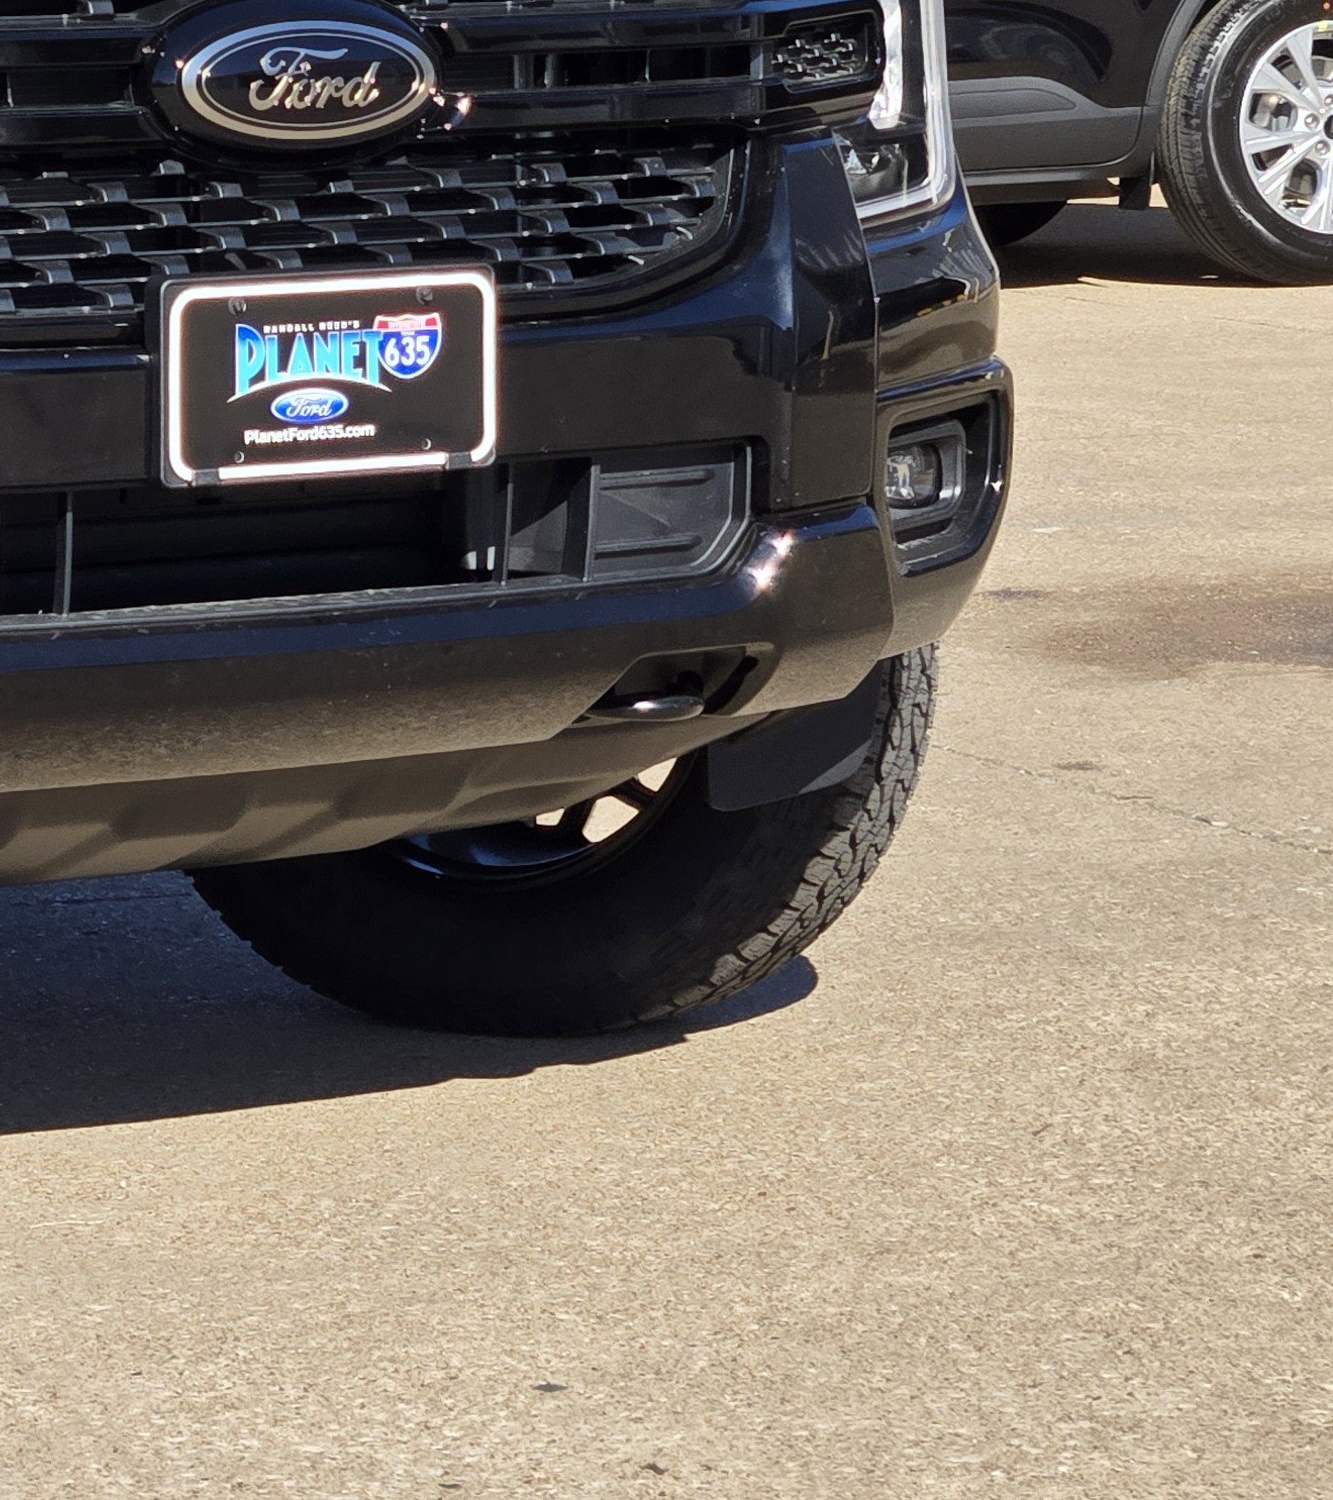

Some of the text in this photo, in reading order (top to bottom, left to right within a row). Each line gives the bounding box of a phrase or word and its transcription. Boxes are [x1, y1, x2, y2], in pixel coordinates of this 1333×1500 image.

[248, 46, 382, 111] Ford
[235, 323, 384, 396] PLANET
[384, 335, 431, 368] 635
[285, 397, 333, 418] Ford
[243, 423, 377, 446] PlanetFord635.com
